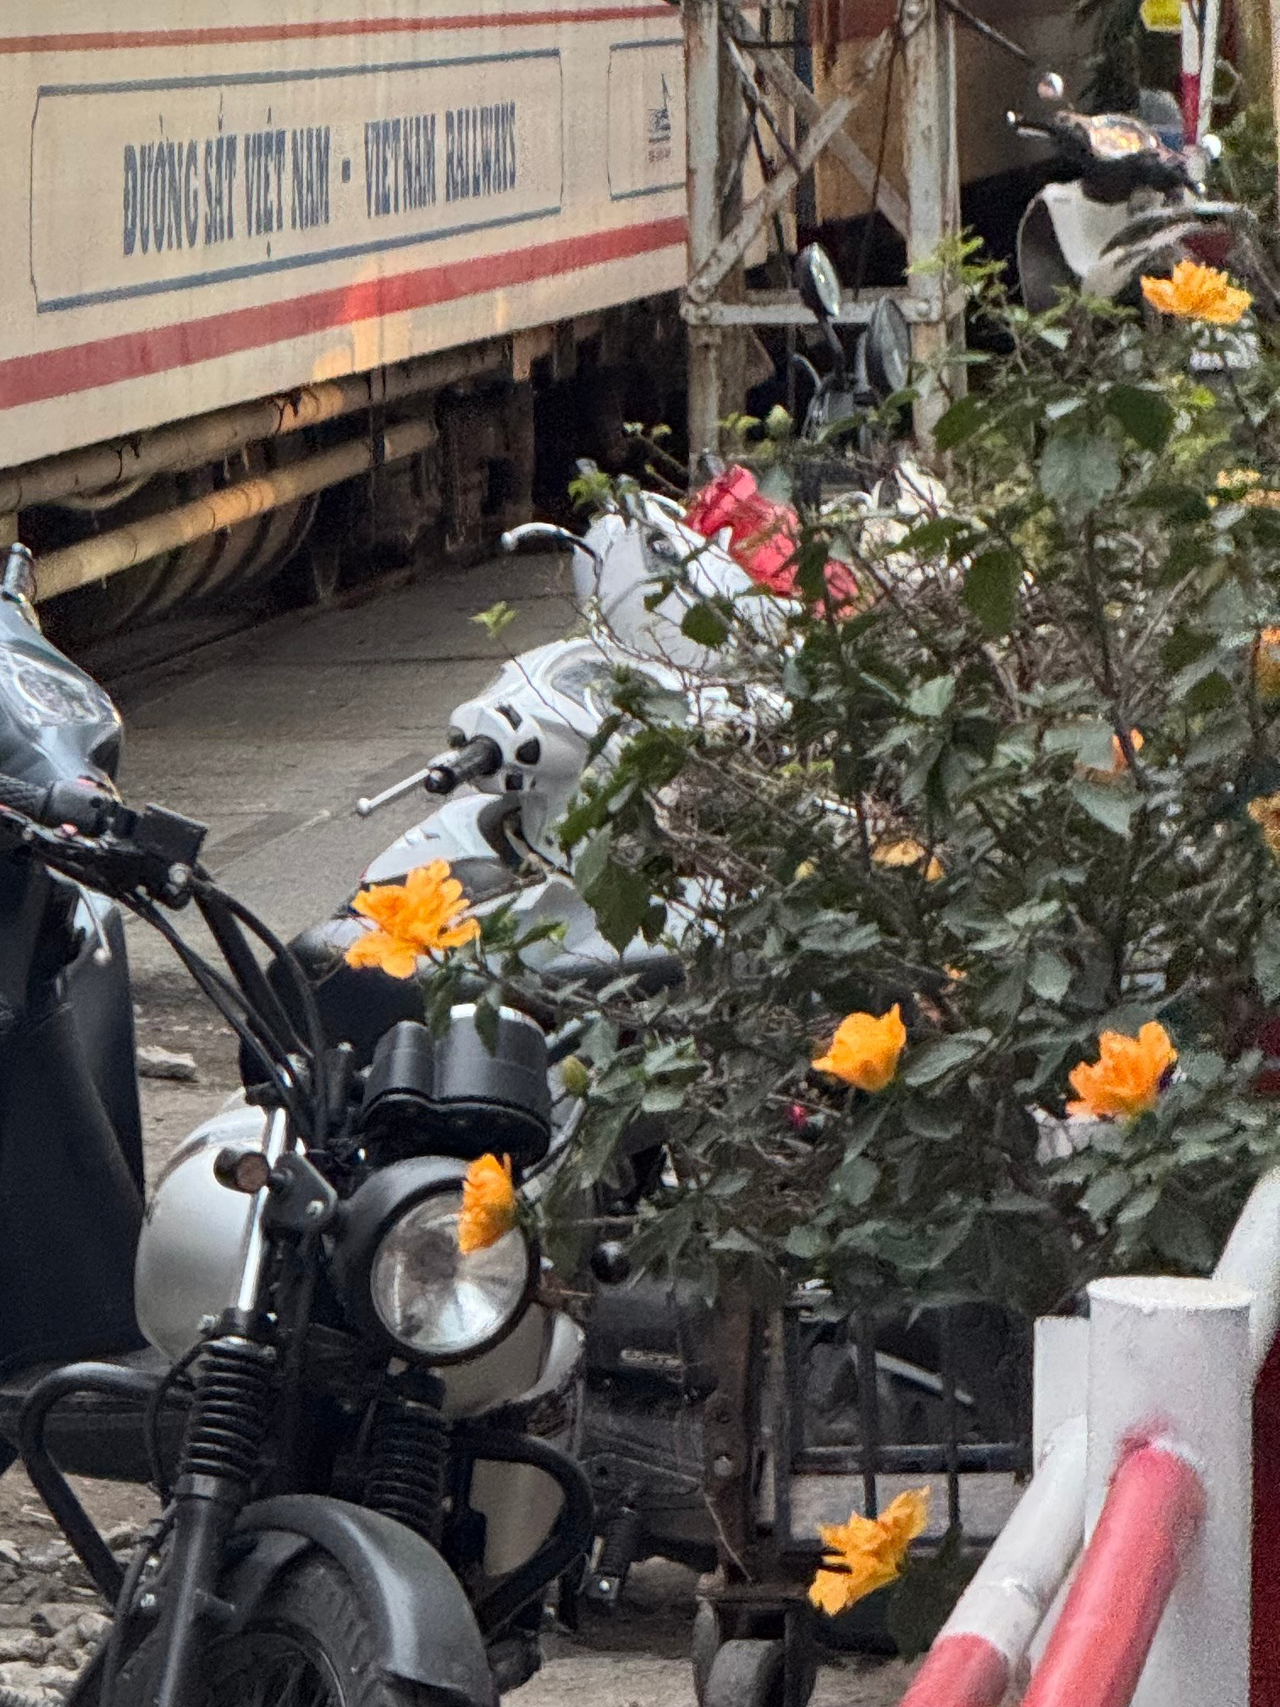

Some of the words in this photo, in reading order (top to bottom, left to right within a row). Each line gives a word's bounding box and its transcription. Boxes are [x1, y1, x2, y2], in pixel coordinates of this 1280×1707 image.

[244, 106, 287, 259] VIỆT
[291, 125, 331, 230] NAM
[445, 100, 516, 203] RAILWAYS
